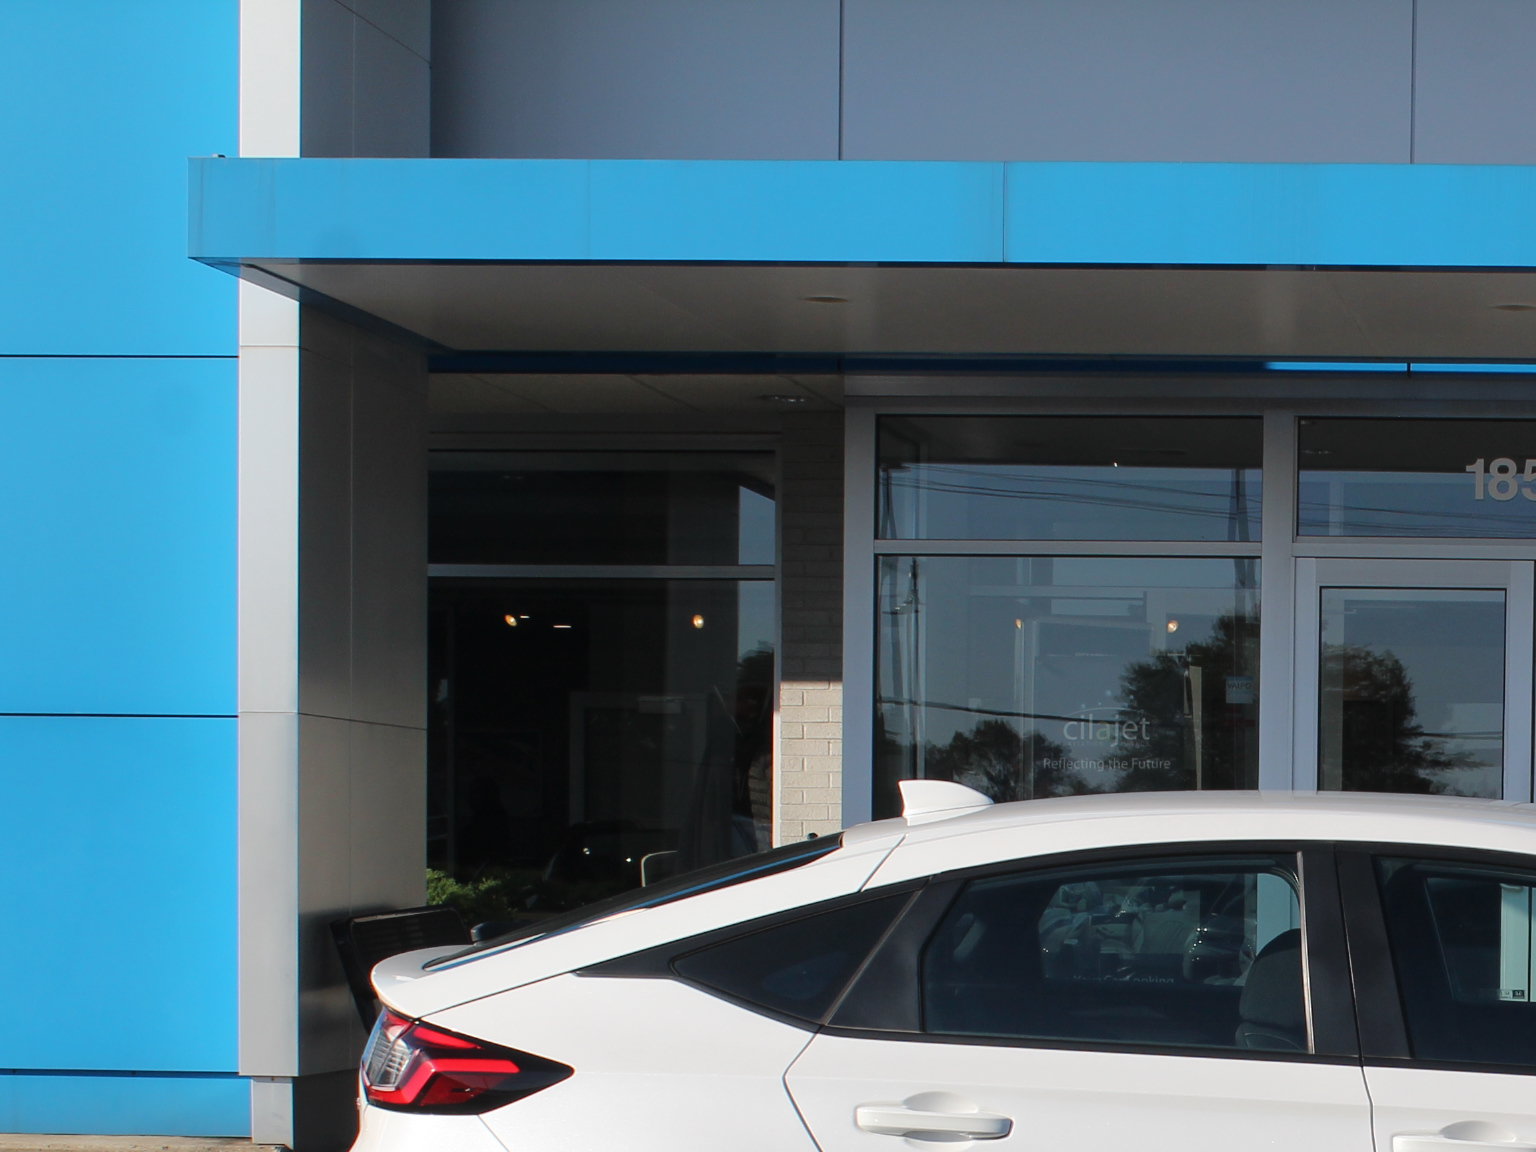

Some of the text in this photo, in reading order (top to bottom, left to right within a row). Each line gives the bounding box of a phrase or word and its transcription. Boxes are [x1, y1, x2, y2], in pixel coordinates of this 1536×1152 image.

[1063, 713, 1151, 747] cilajet
[1043, 757, 1171, 772] Reflecting the Future
